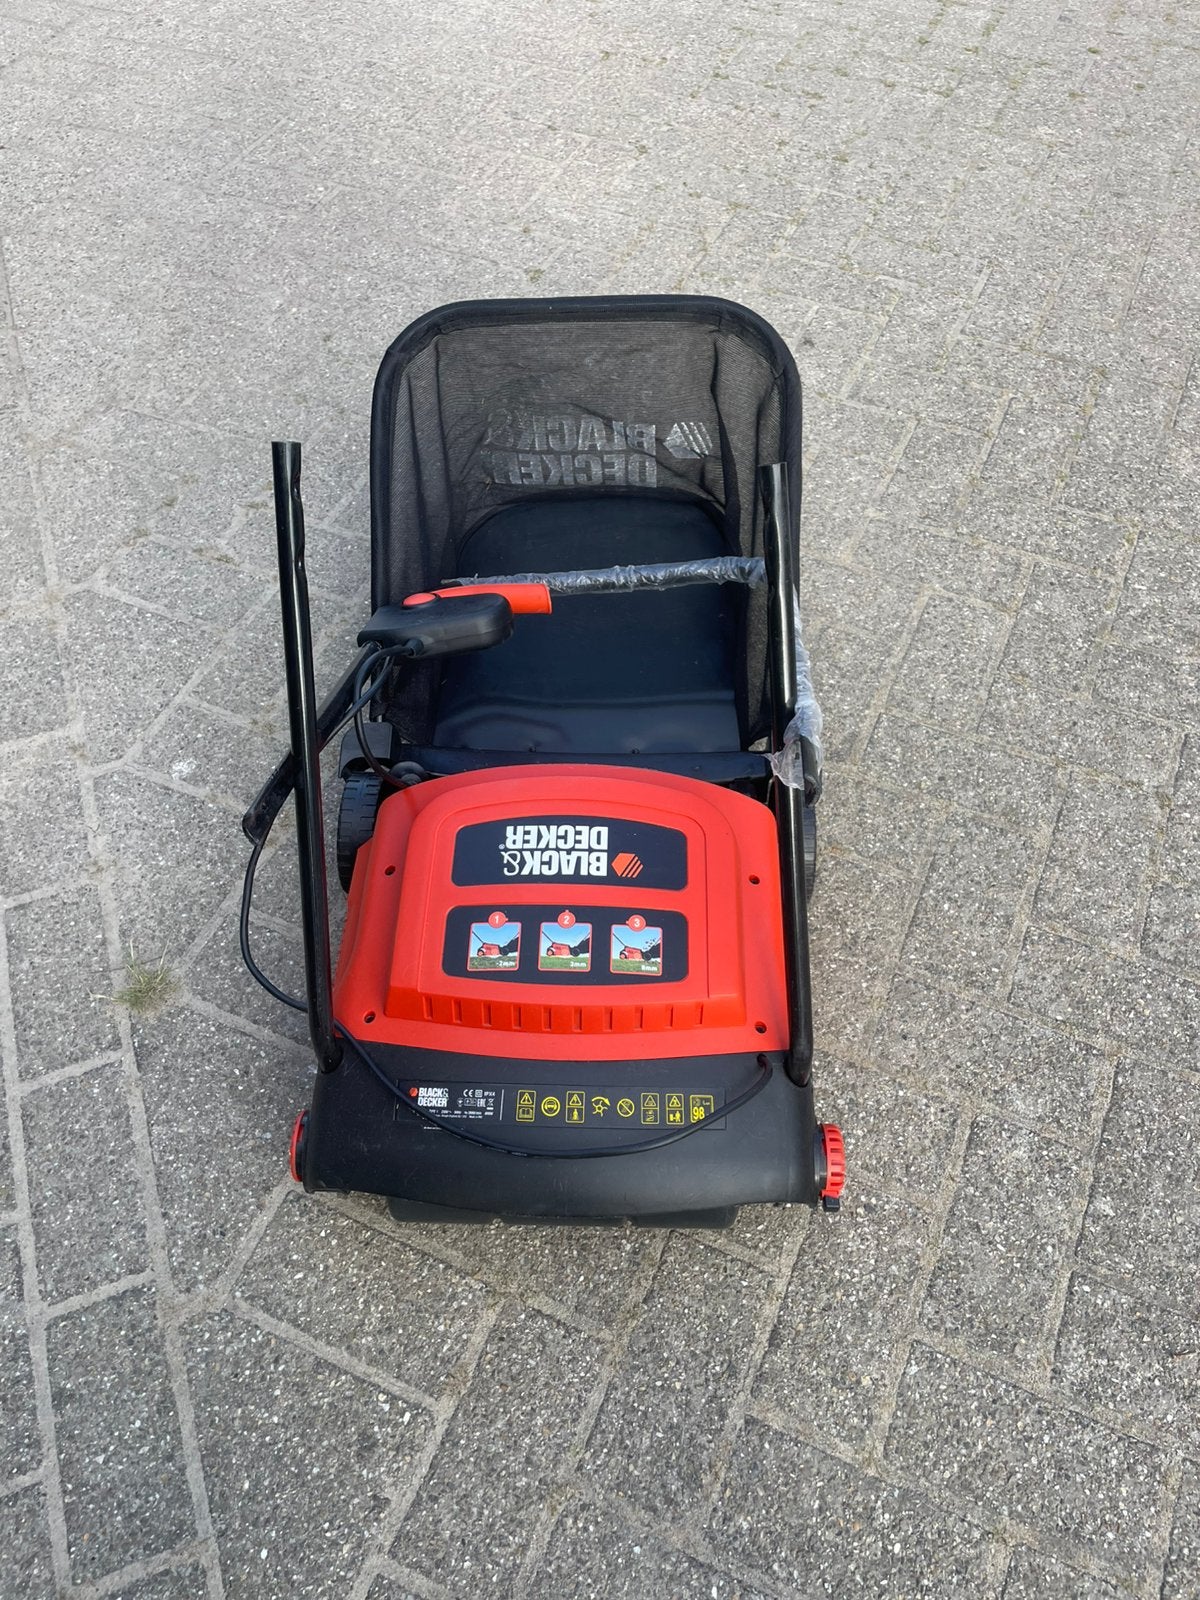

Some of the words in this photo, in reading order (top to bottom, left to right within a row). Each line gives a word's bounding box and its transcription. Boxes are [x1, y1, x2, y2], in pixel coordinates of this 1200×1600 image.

[501, 850, 608, 877] BLACK&
[494, 915, 500, 924] 1
[563, 915, 570, 925] 2
[633, 918, 640, 927] 3
[418, 1087, 449, 1098] BLACK&
[417, 1097, 448, 1107] DECKER
[692, 1106, 705, 1120] 98
